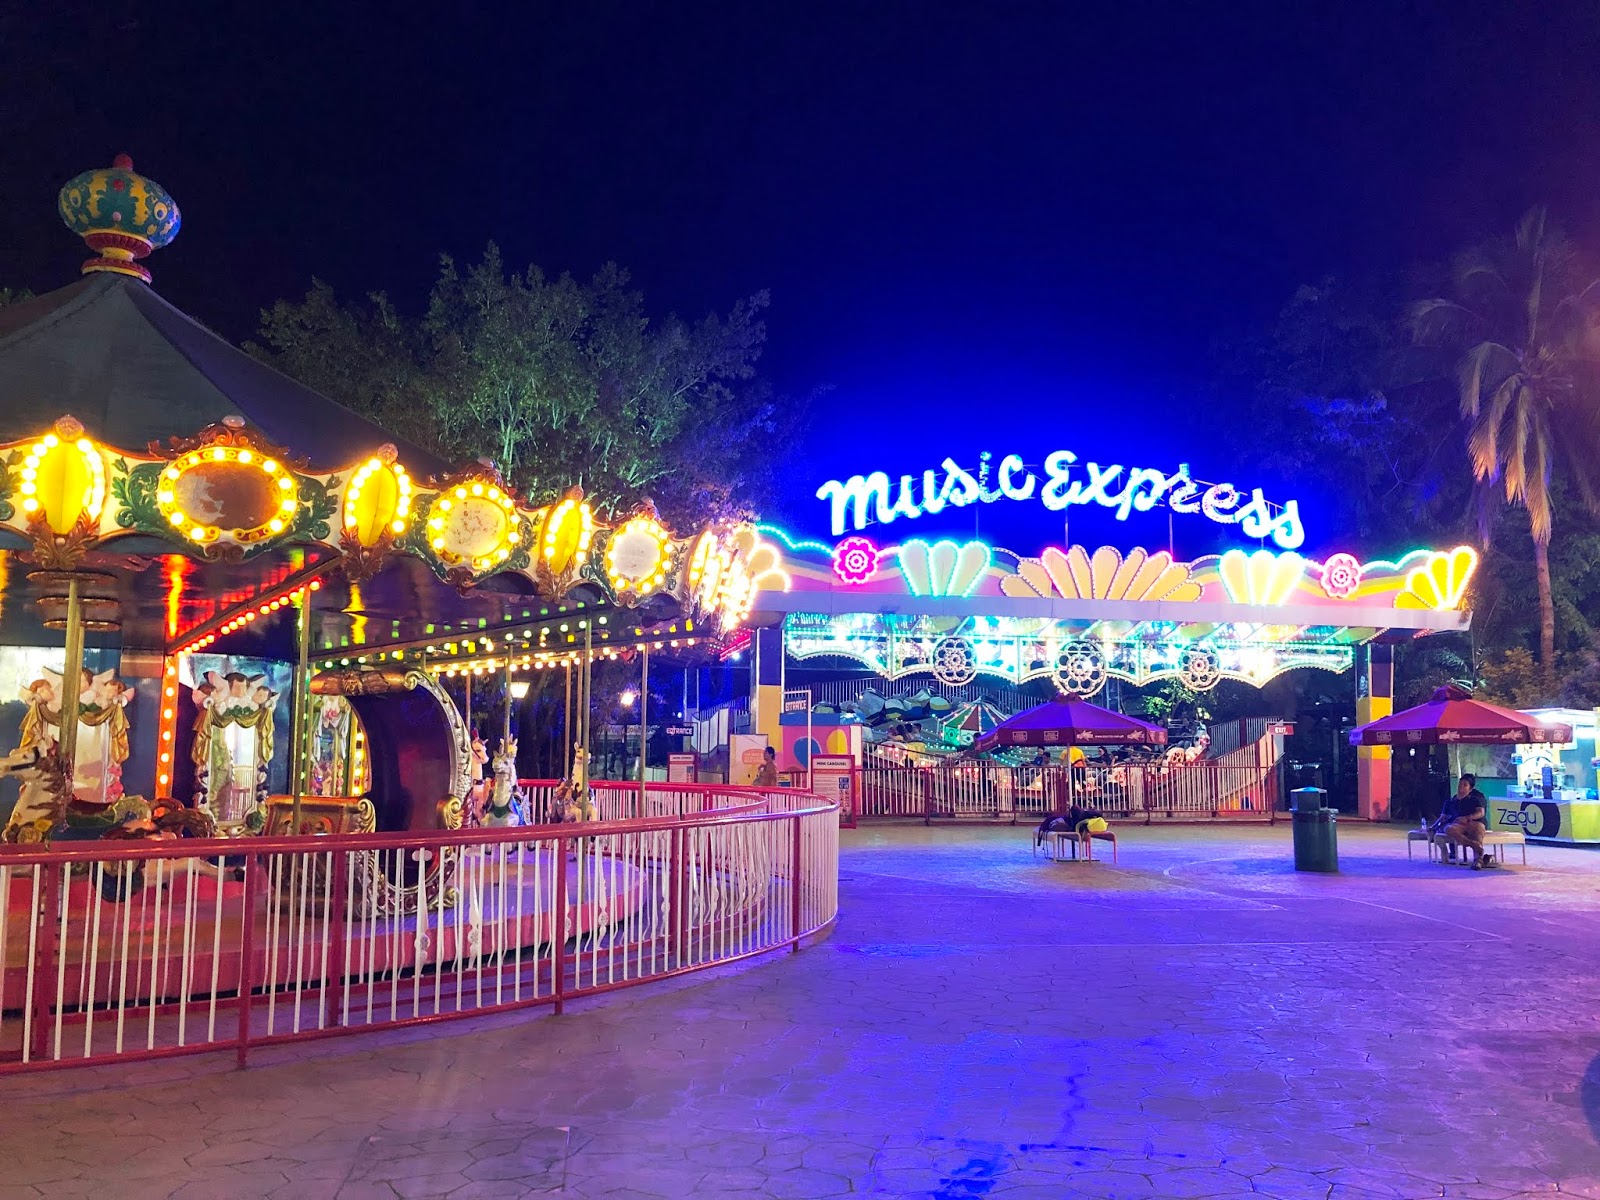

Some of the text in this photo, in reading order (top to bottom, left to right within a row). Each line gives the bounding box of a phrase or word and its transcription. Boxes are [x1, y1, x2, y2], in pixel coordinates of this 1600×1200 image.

[1041, 450, 1306, 548] Express
[785, 700, 807, 712] ENTRANCE
[1274, 726, 1287, 734] EXIT
[1497, 808, 1537, 828] Zagu
